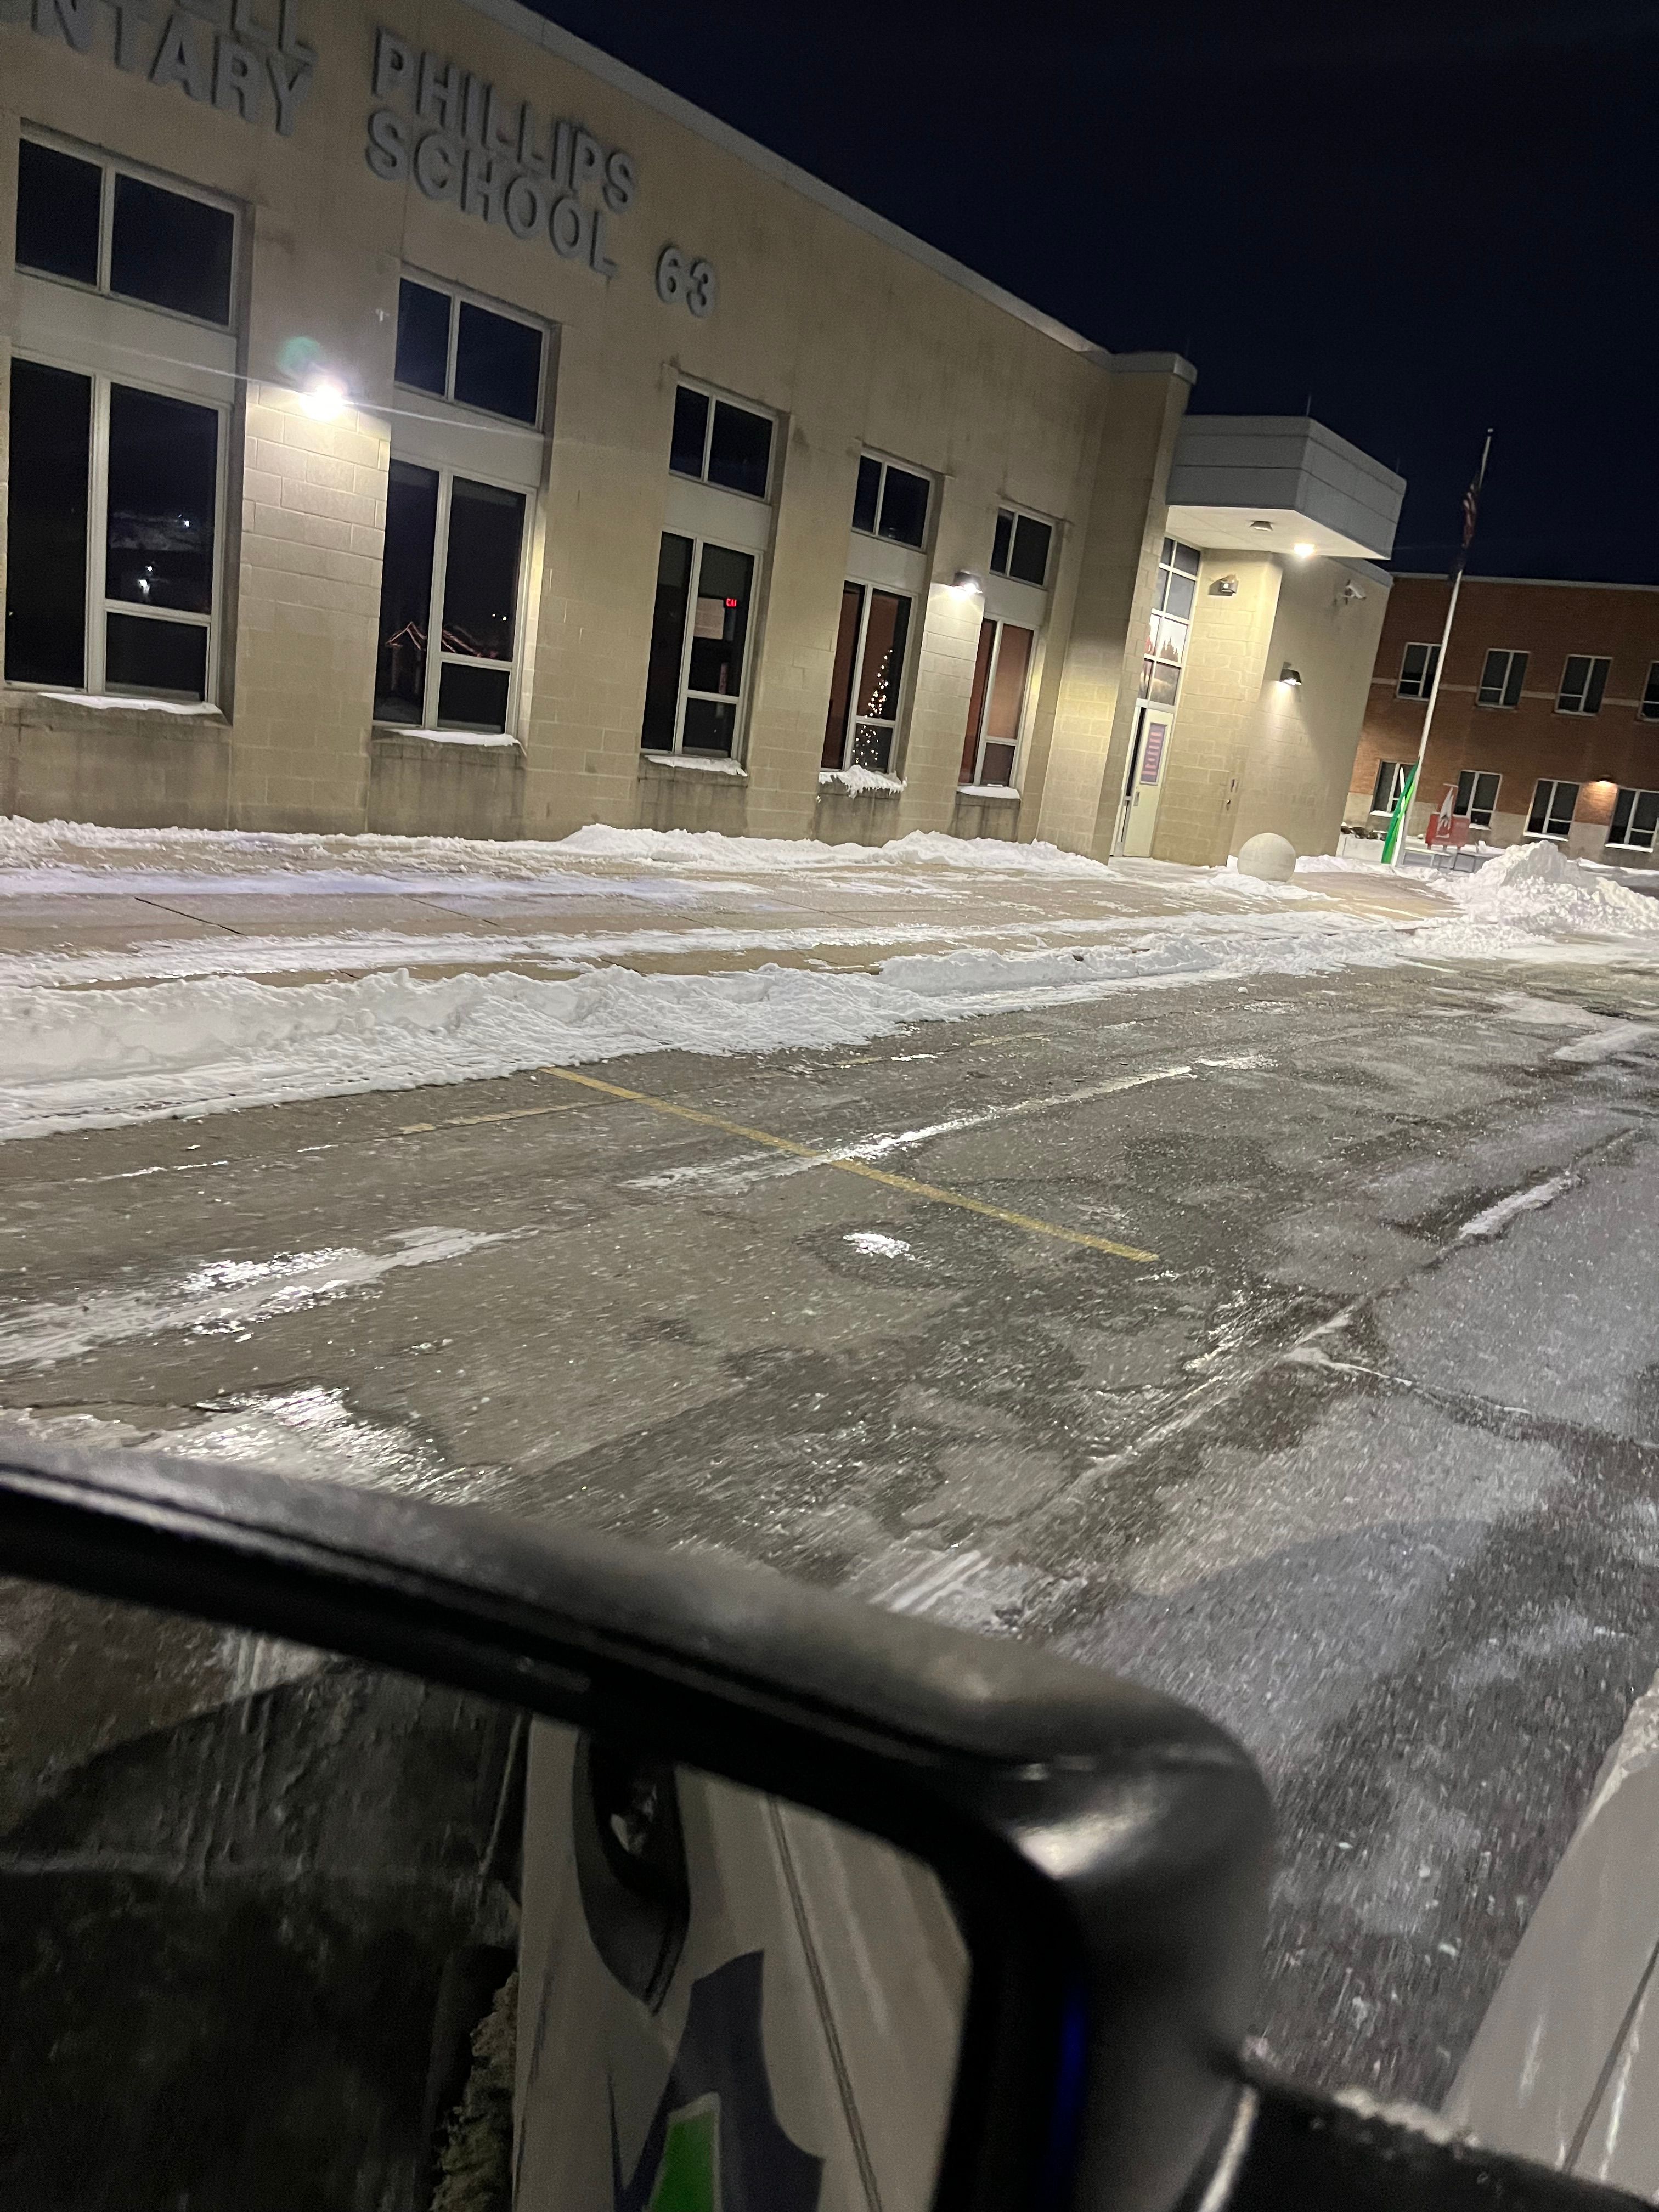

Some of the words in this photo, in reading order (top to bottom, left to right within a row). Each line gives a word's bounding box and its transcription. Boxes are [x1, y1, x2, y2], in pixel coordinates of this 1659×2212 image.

[0, 0, 316, 136] NTARY
[365, 109, 618, 279] SCHOOL
[655, 243, 715, 318] 63
[371, 25, 637, 213] PHILLIPS
